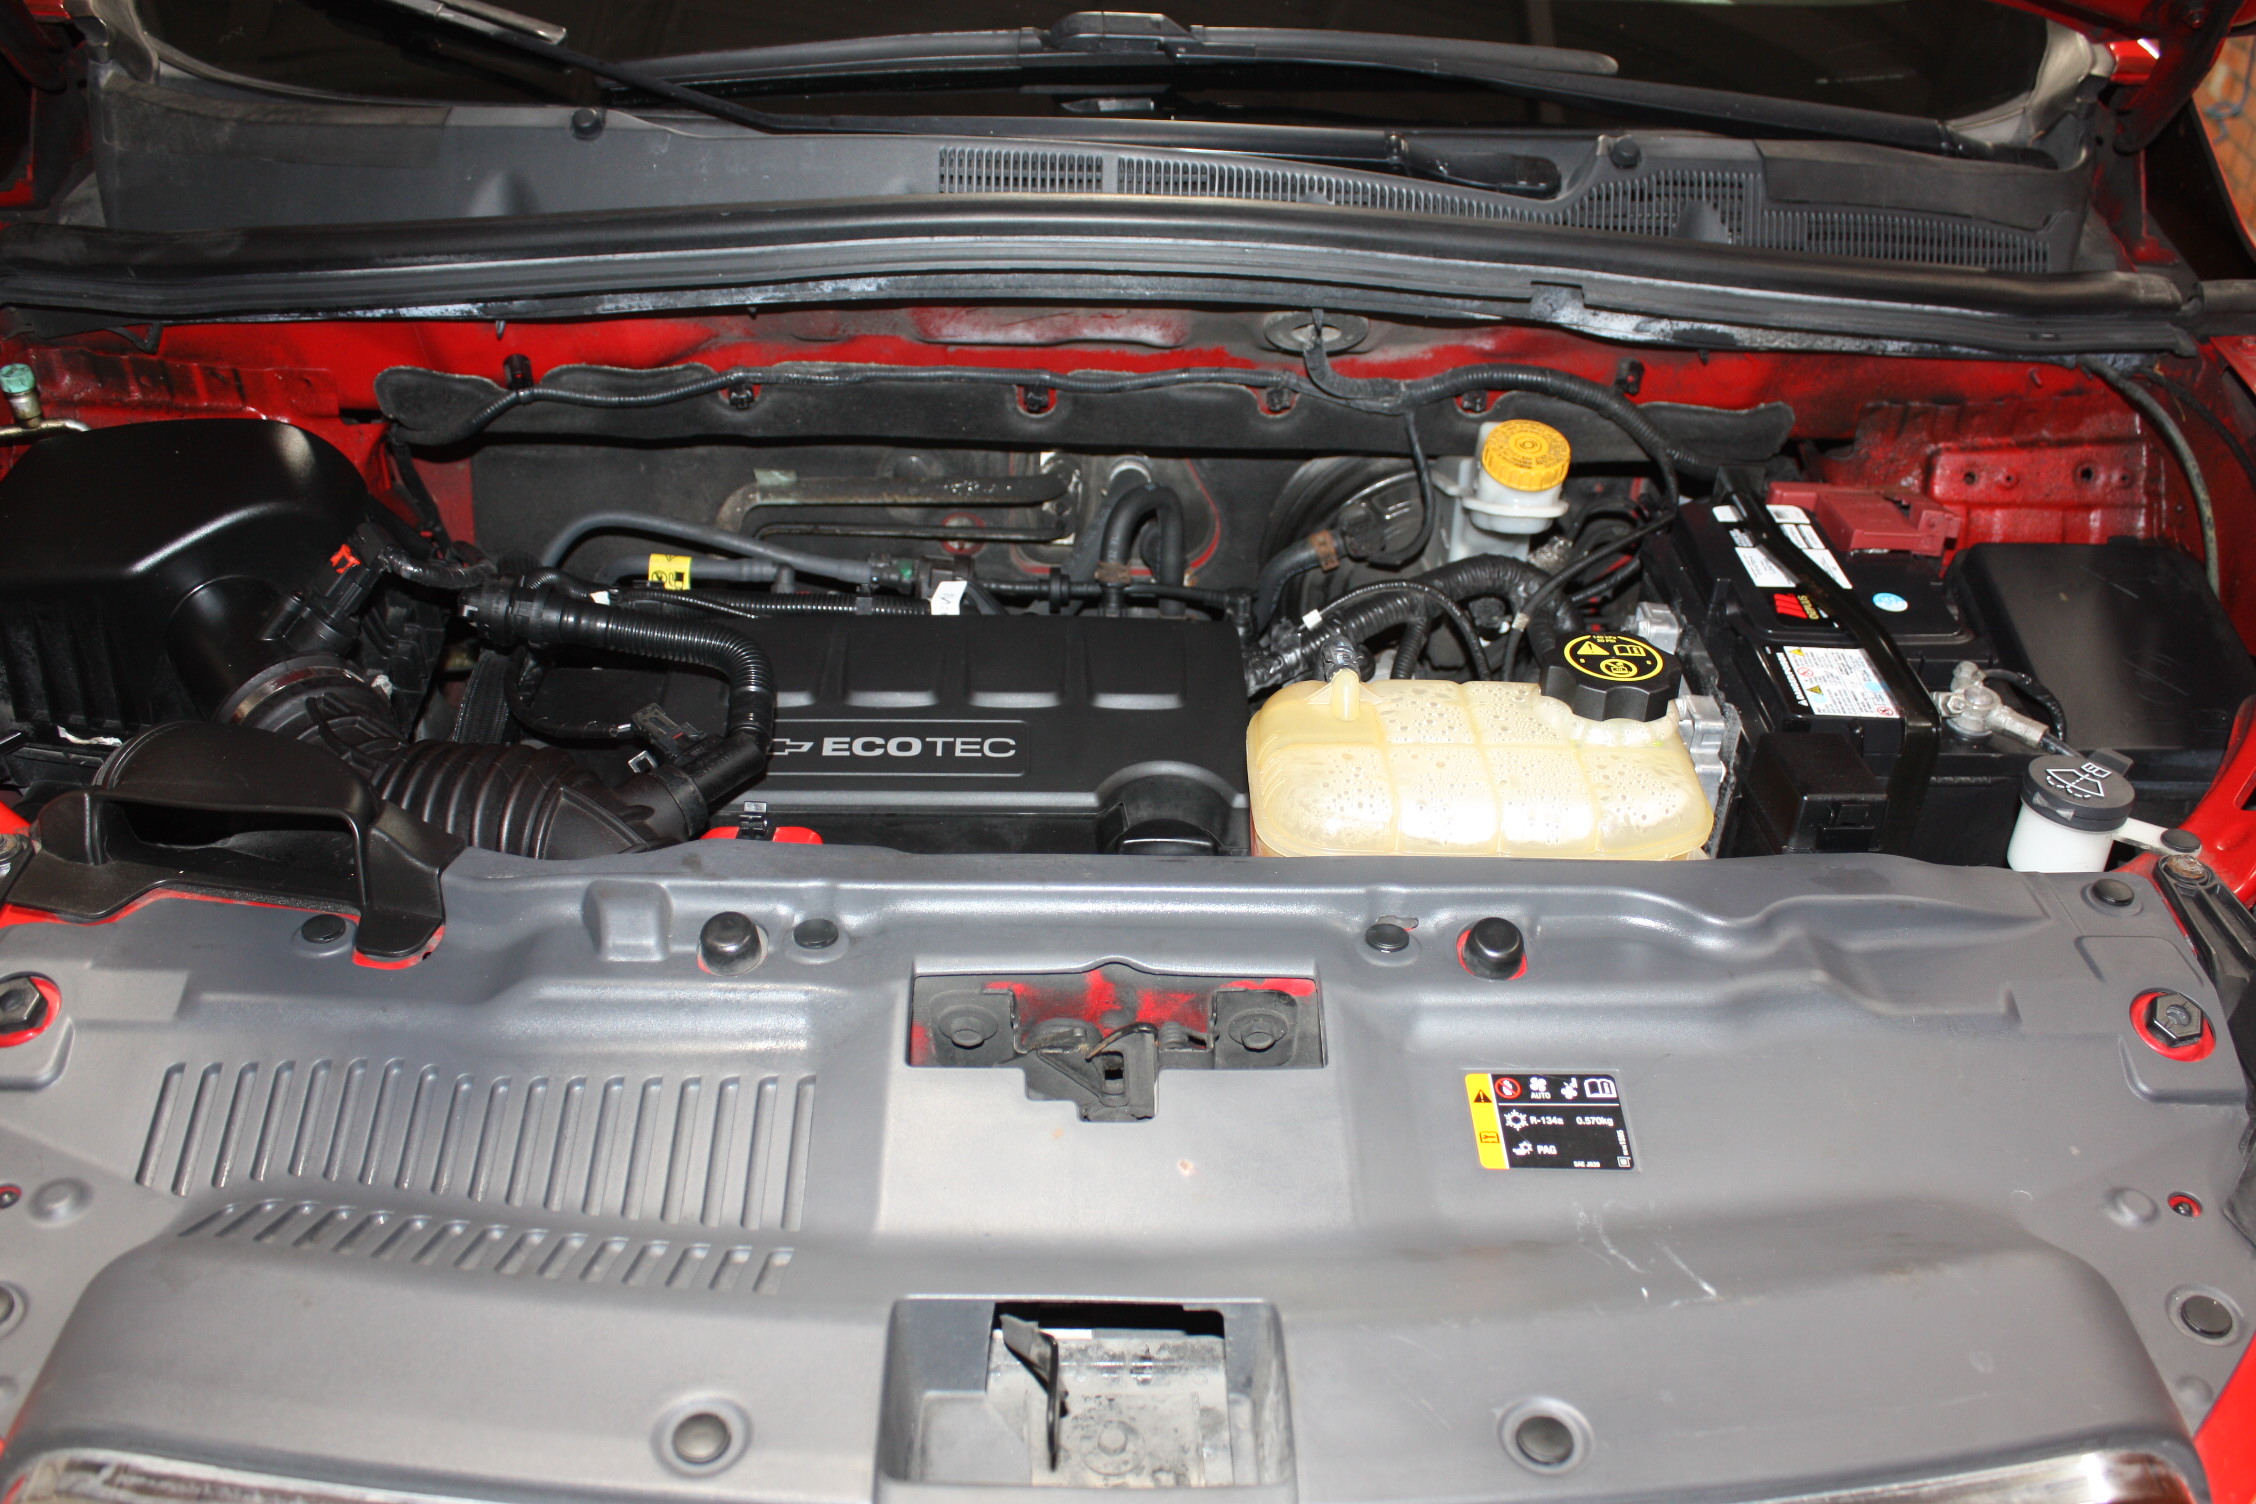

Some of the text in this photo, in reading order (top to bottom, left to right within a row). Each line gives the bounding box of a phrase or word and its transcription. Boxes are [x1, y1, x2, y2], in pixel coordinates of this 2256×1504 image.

[821, 736, 1017, 758] ECOTEC
[1529, 1116, 1614, 1127] R-134a 0.570kg
[1536, 1145, 1558, 1155] PAG
